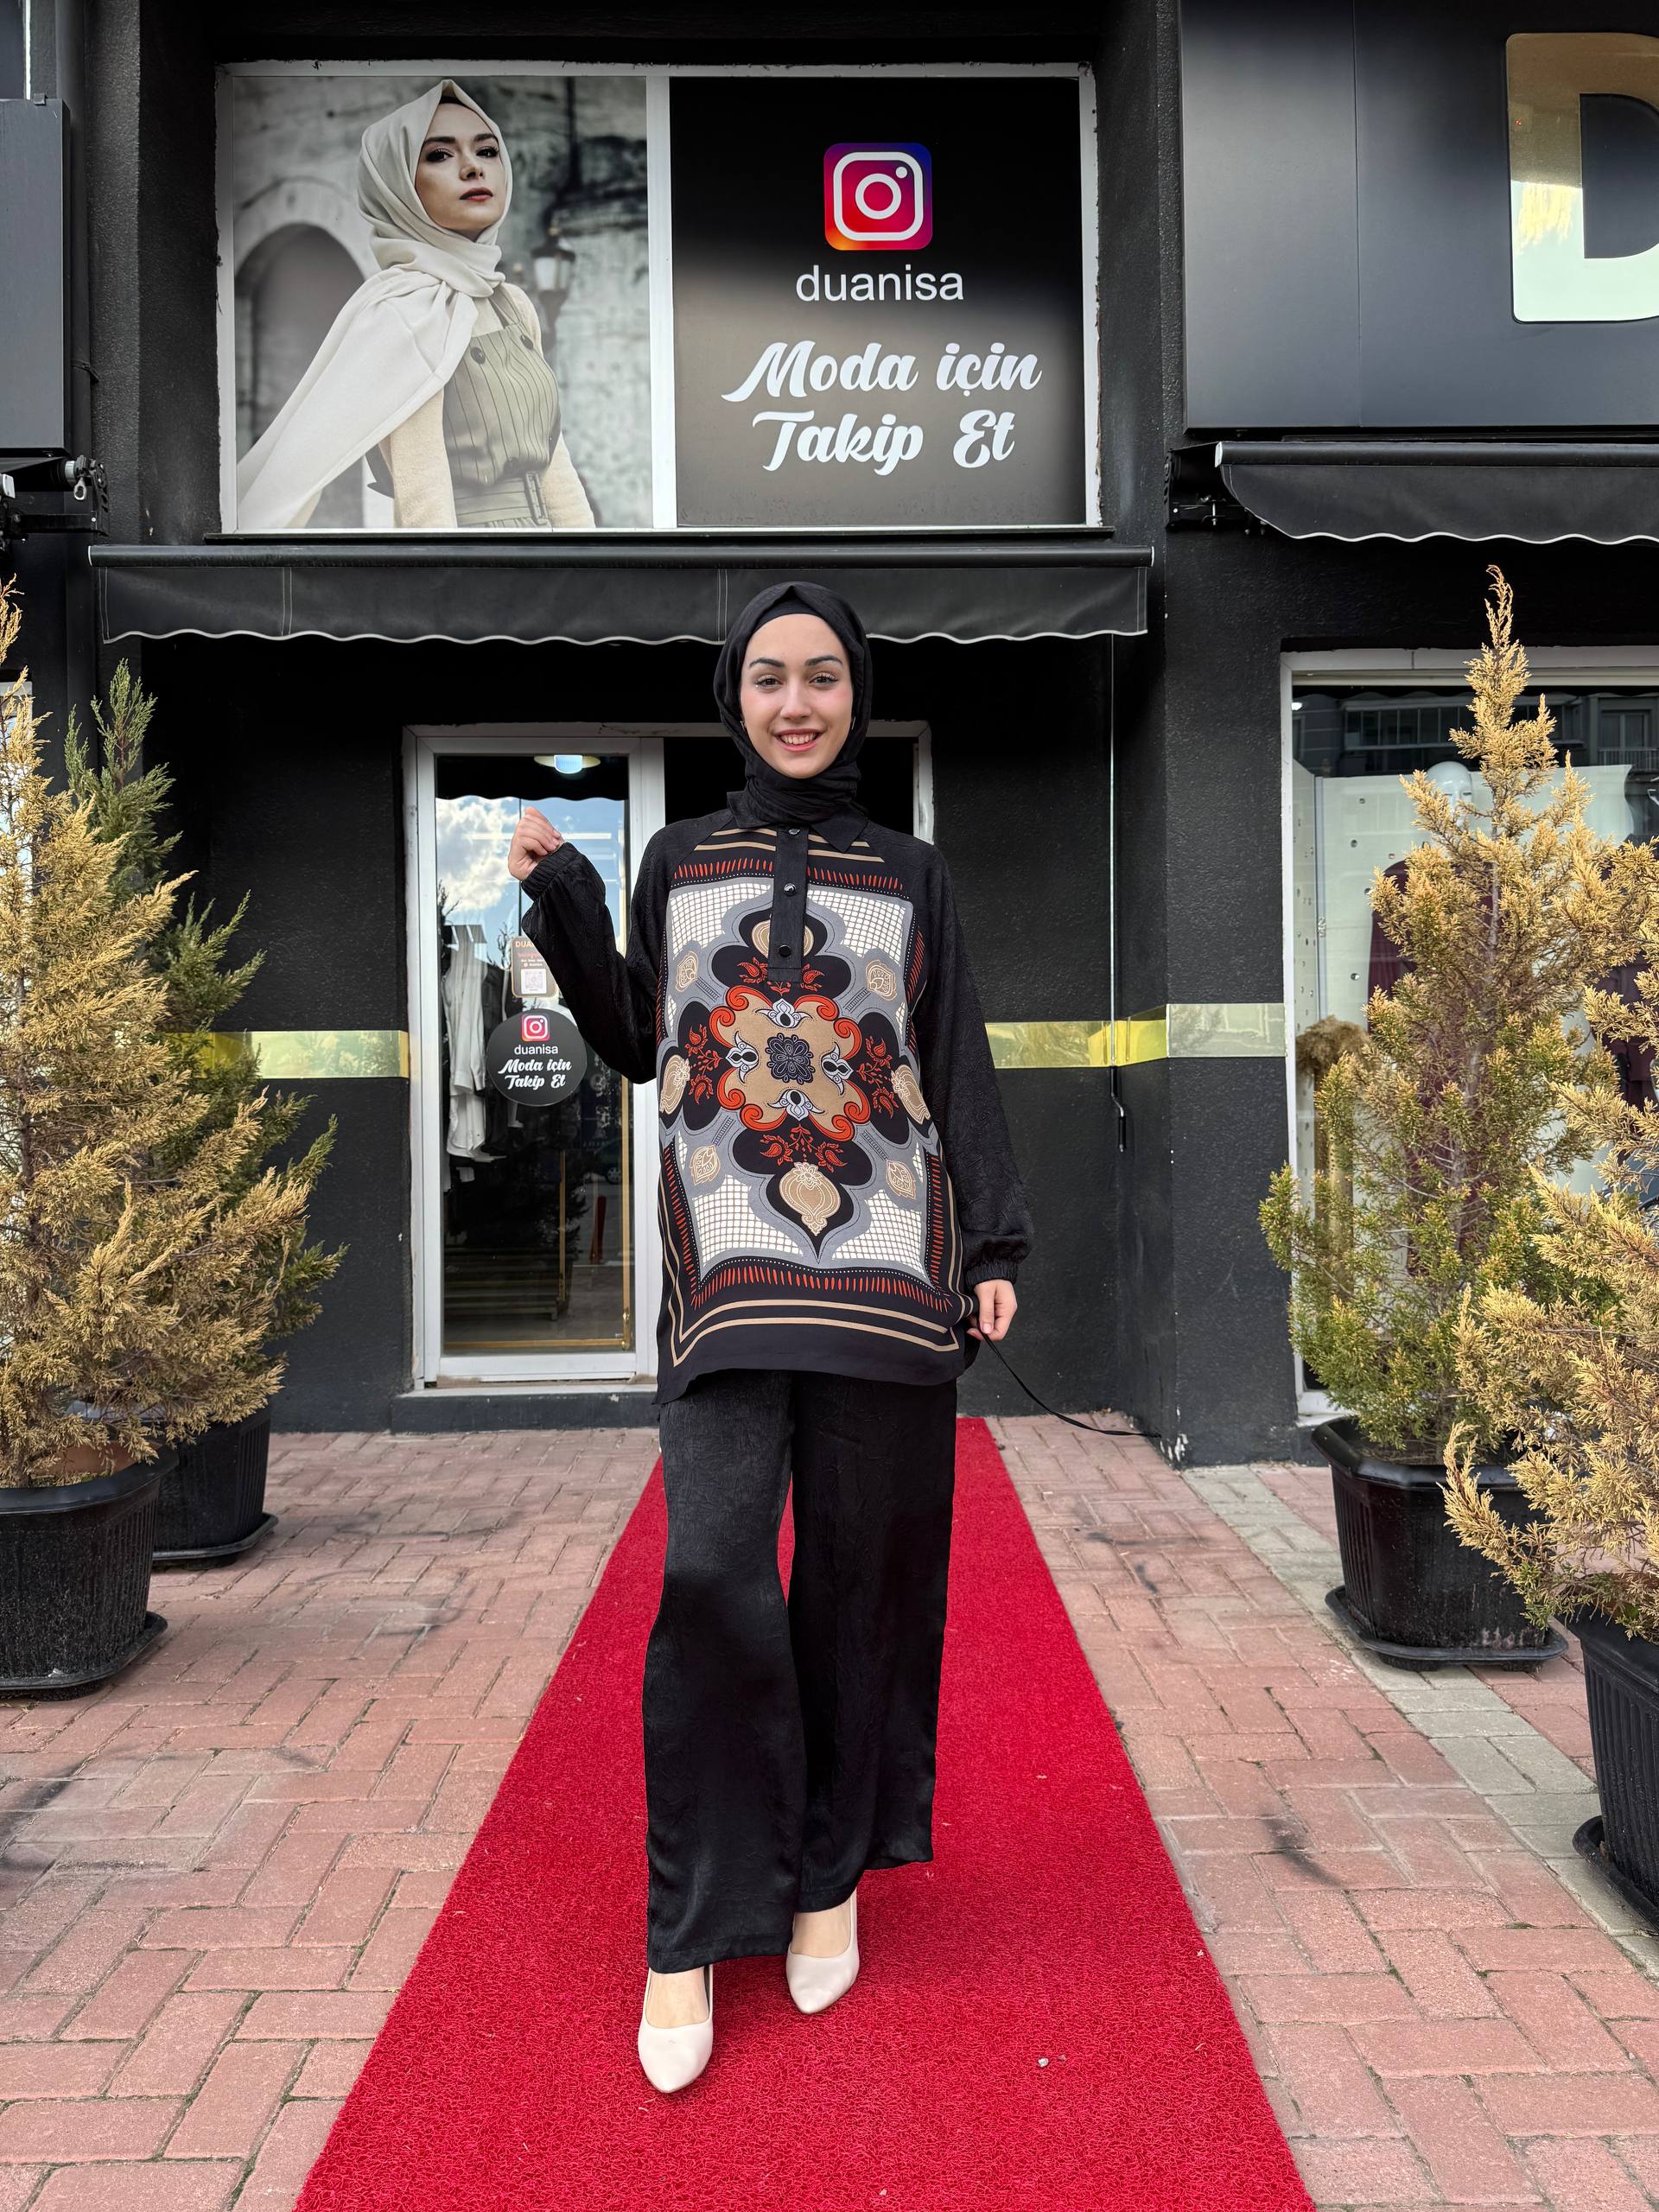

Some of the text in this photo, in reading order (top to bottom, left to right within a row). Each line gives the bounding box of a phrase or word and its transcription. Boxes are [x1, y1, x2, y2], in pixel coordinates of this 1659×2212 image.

[796, 264, 964, 302] duanisa
[721, 340, 1042, 403] Moda için
[753, 409, 1015, 476] Takip Et
[514, 1043, 559, 1055] duanisa
[498, 1058, 572, 1074] Moda için
[505, 1074, 566, 1090] Takip Et
